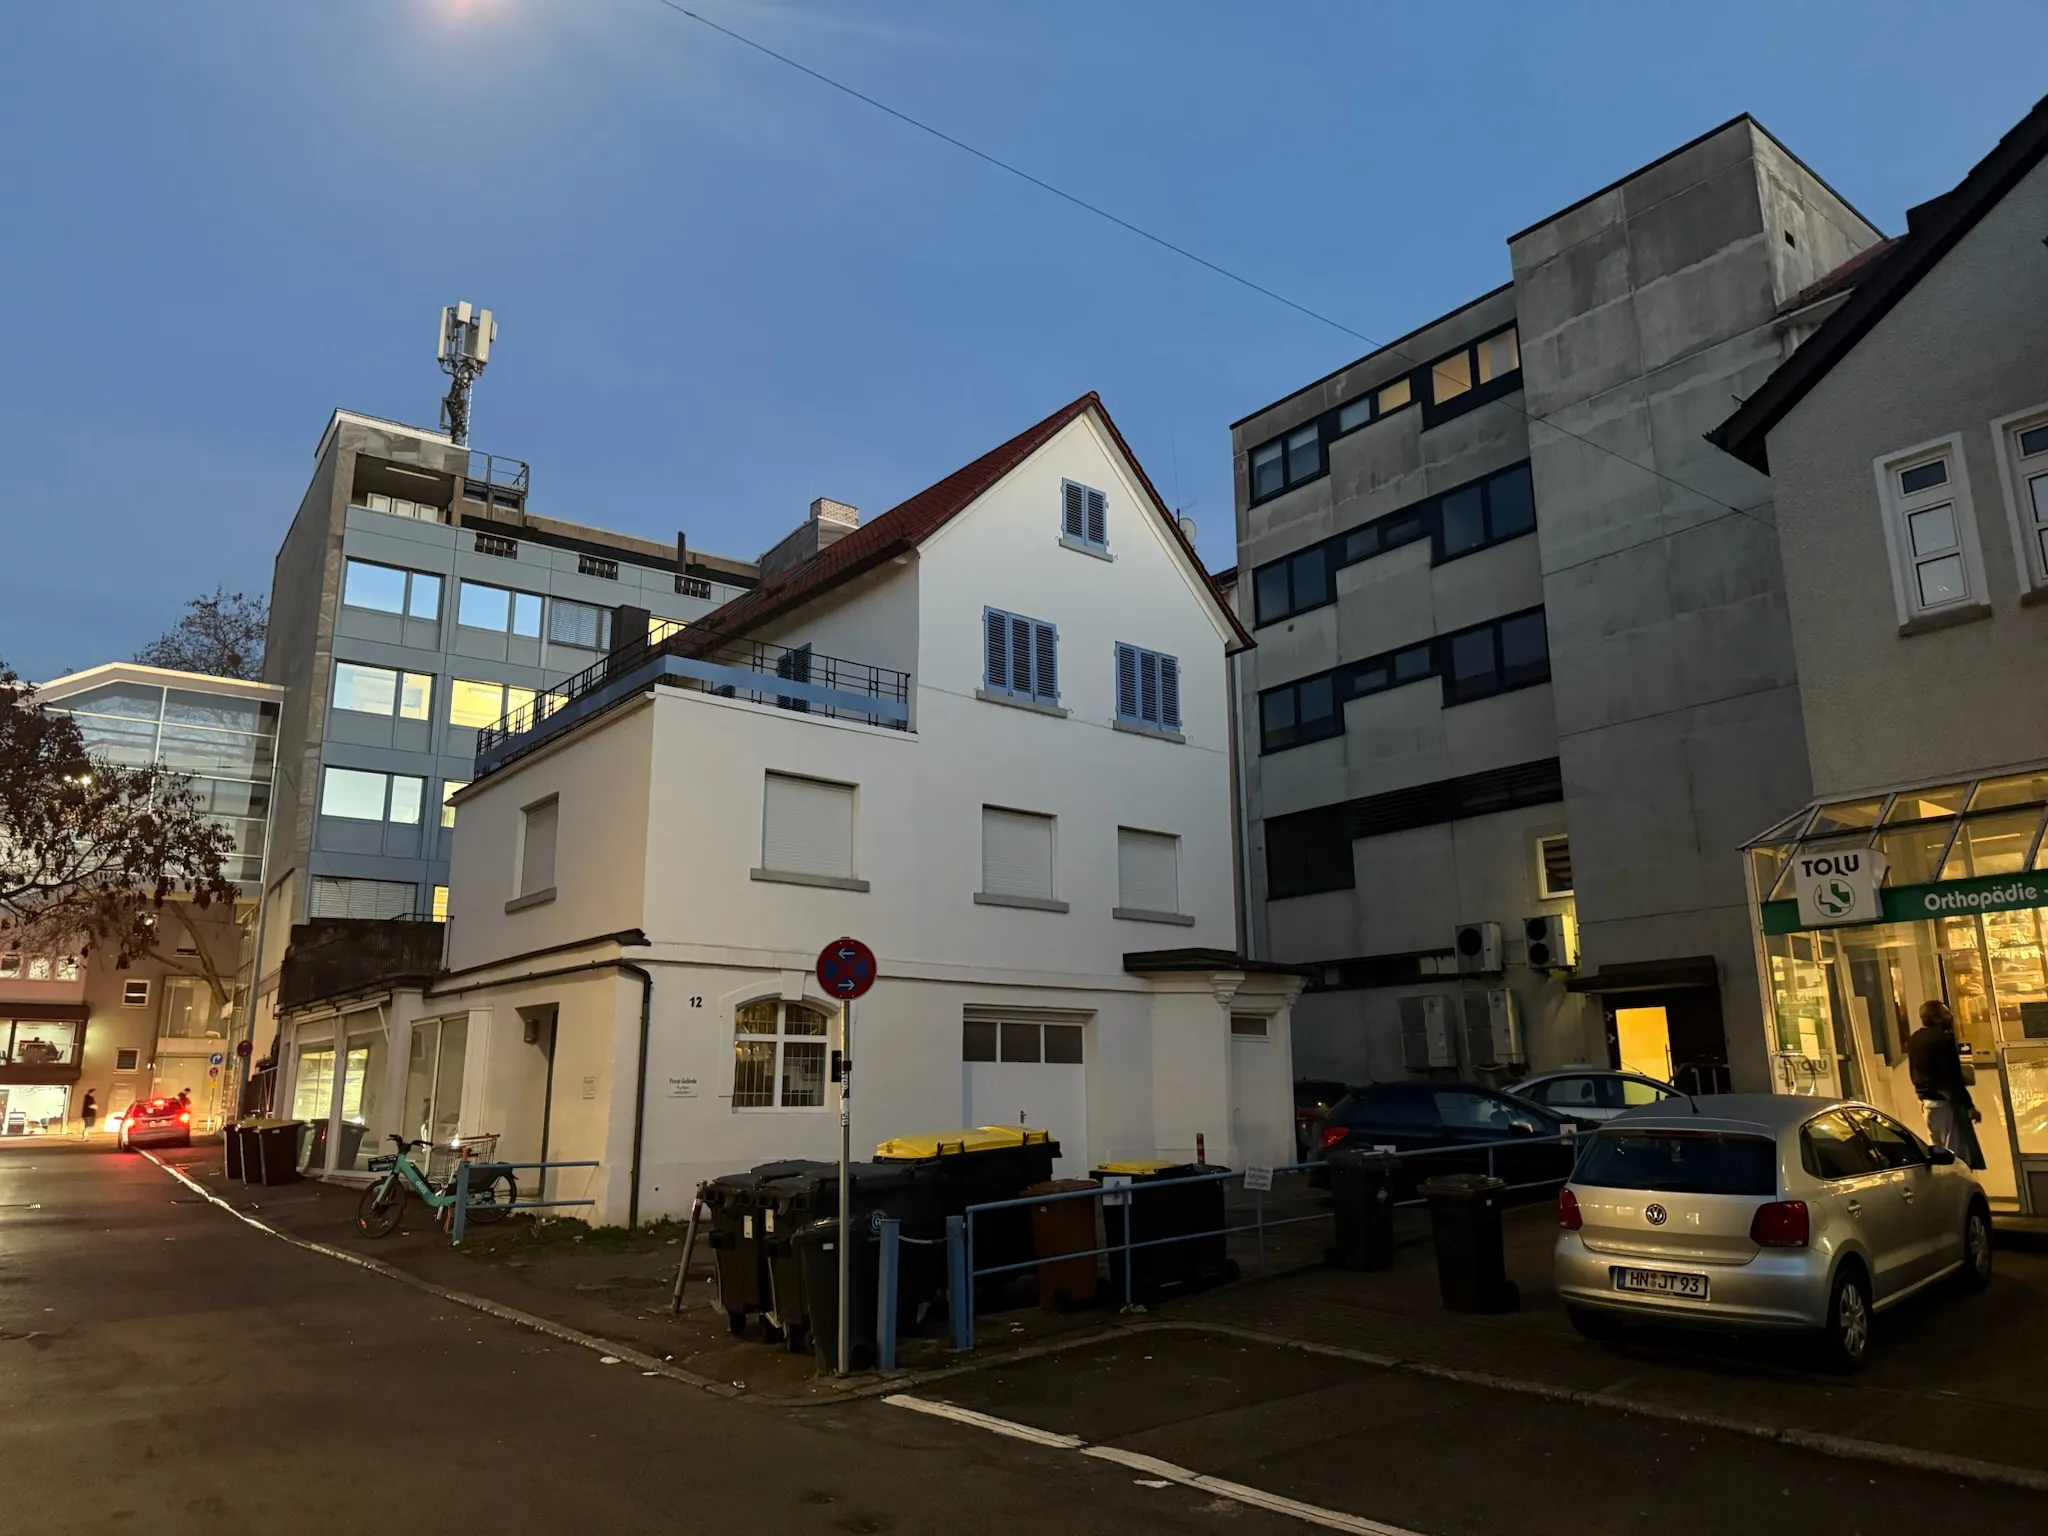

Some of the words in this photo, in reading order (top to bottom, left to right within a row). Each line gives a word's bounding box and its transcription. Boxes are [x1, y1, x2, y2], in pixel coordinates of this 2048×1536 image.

[1801, 854, 1860, 878] TOLU
[1924, 882, 2038, 911] Orthopädie
[689, 996, 703, 1008] 12
[1630, 1271, 1649, 1287] HN
[1658, 1274, 1678, 1290] JT
[1680, 1277, 1700, 1293] 93
